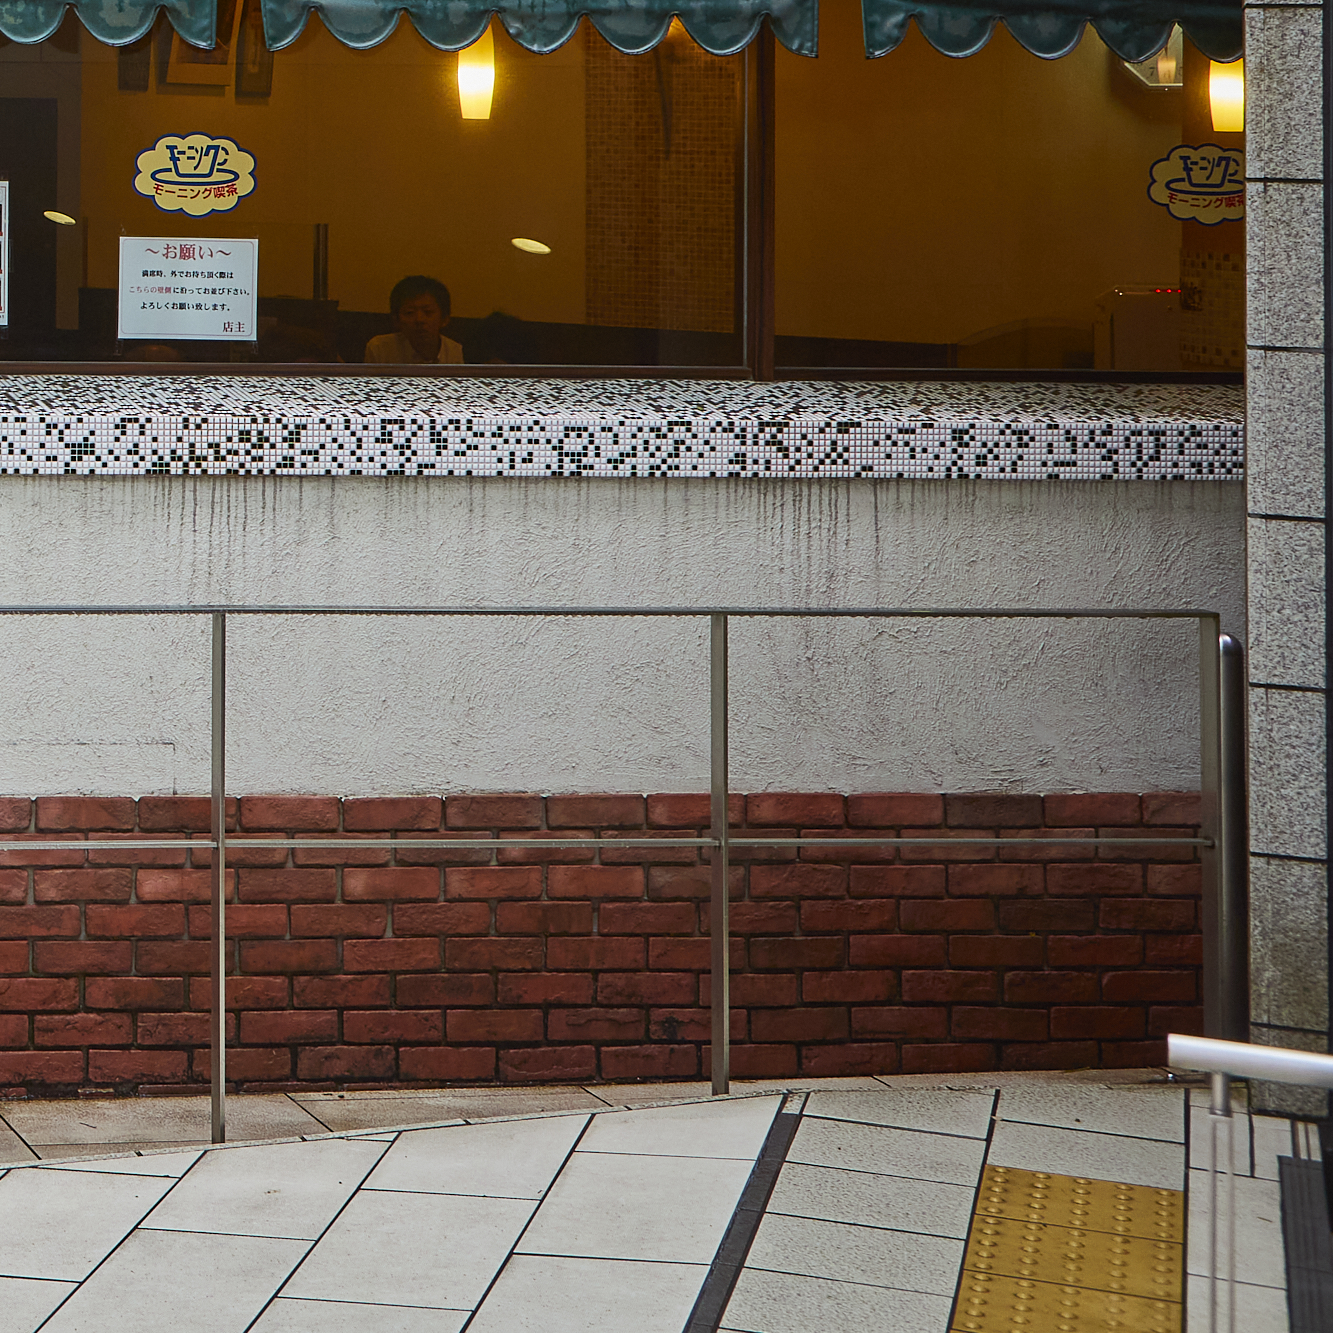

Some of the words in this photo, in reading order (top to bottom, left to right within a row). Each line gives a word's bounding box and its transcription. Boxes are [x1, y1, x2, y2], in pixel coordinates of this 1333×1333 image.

[153, 183, 239, 200] モーニング喫茶
[222, 321, 246, 333] 店主
